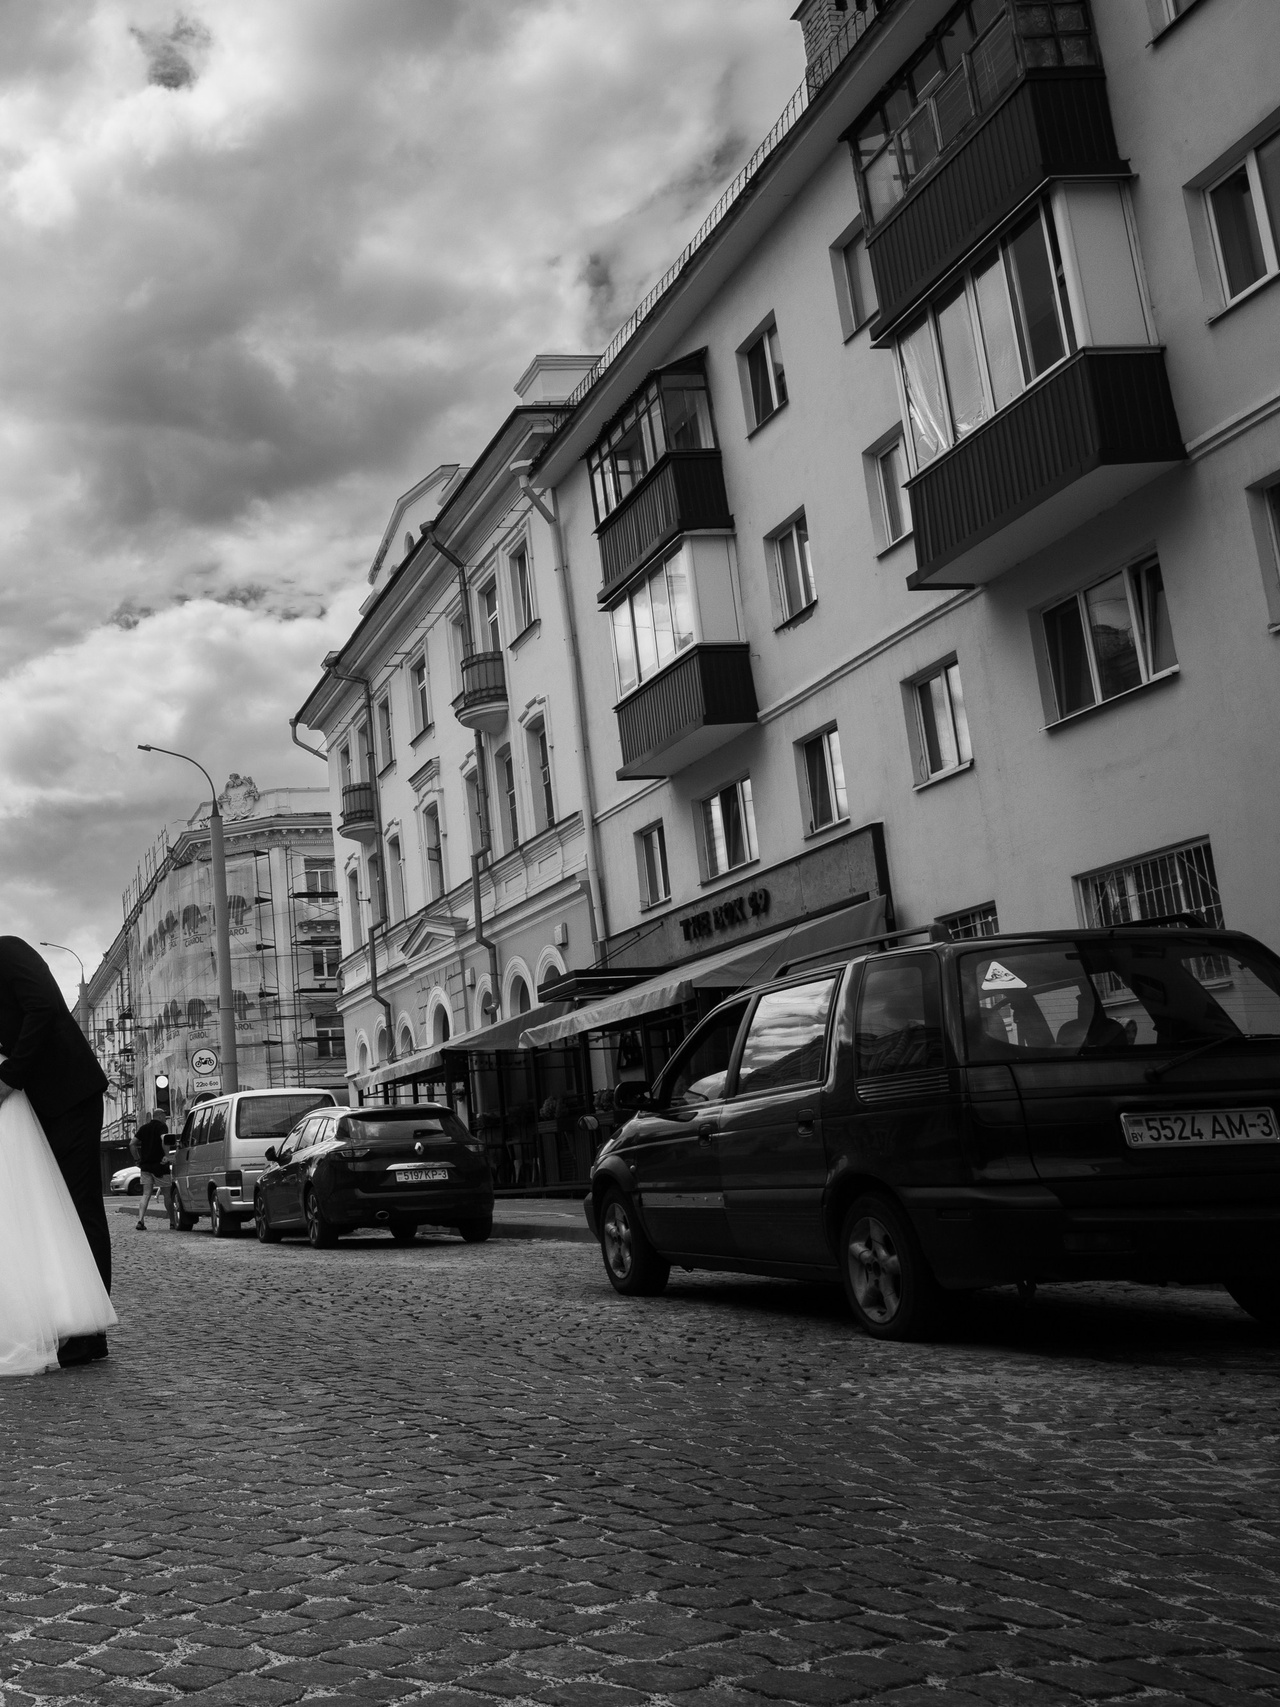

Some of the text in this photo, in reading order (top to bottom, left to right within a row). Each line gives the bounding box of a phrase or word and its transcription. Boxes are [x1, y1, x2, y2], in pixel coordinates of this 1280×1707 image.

[679, 911, 712, 941] THE
[229, 927, 249, 936] AROL
[234, 1022, 254, 1031] AROL
[1145, 1113, 1273, 1141] 5524 AM-3
[1131, 1132, 1144, 1142] BY
[403, 1169, 447, 1180] 5197 KP-3
